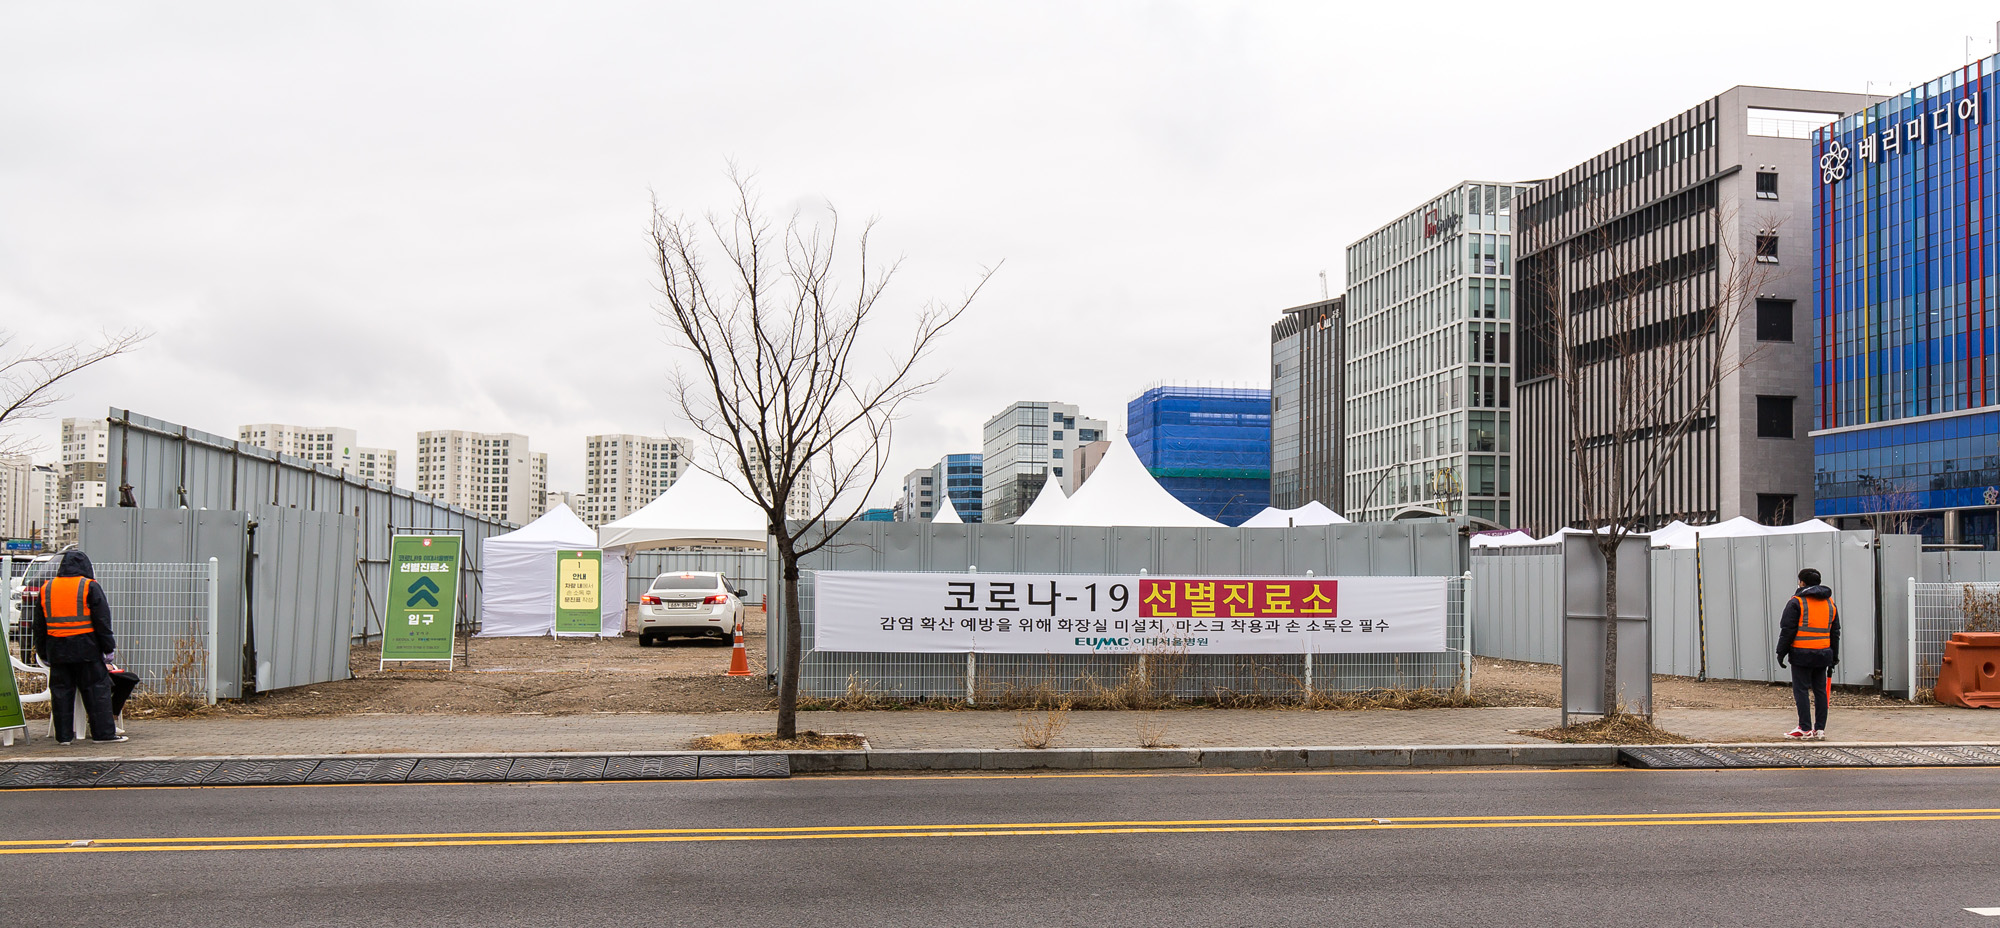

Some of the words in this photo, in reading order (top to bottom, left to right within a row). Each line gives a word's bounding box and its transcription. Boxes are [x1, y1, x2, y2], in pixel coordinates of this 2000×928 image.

[1858, 91, 1980, 164] 베리미디어
[400, 562, 449, 573] 선별진료소
[578, 561, 581, 569] 1
[572, 573, 587, 581] 안내
[943, 580, 1130, 617] 코로나-19
[1143, 581, 1334, 618] 선별진료소
[880, 616, 913, 632] 감염
[920, 617, 955, 632] 확산
[960, 617, 1012, 632] 예방을
[1018, 618, 1051, 633] 위해
[1057, 618, 1109, 633] 화장실
[1114, 619, 1170, 634] 미설치,
[1176, 619, 1226, 633] 마스크
[1231, 619, 1281, 633] 착용과
[1285, 619, 1301, 633] 손
[1306, 619, 1354, 633] 소독은
[1359, 619, 1390, 633] 필수
[1074, 637, 1130, 650] EUMC
[1133, 637, 1209, 647] 이대서울병원
